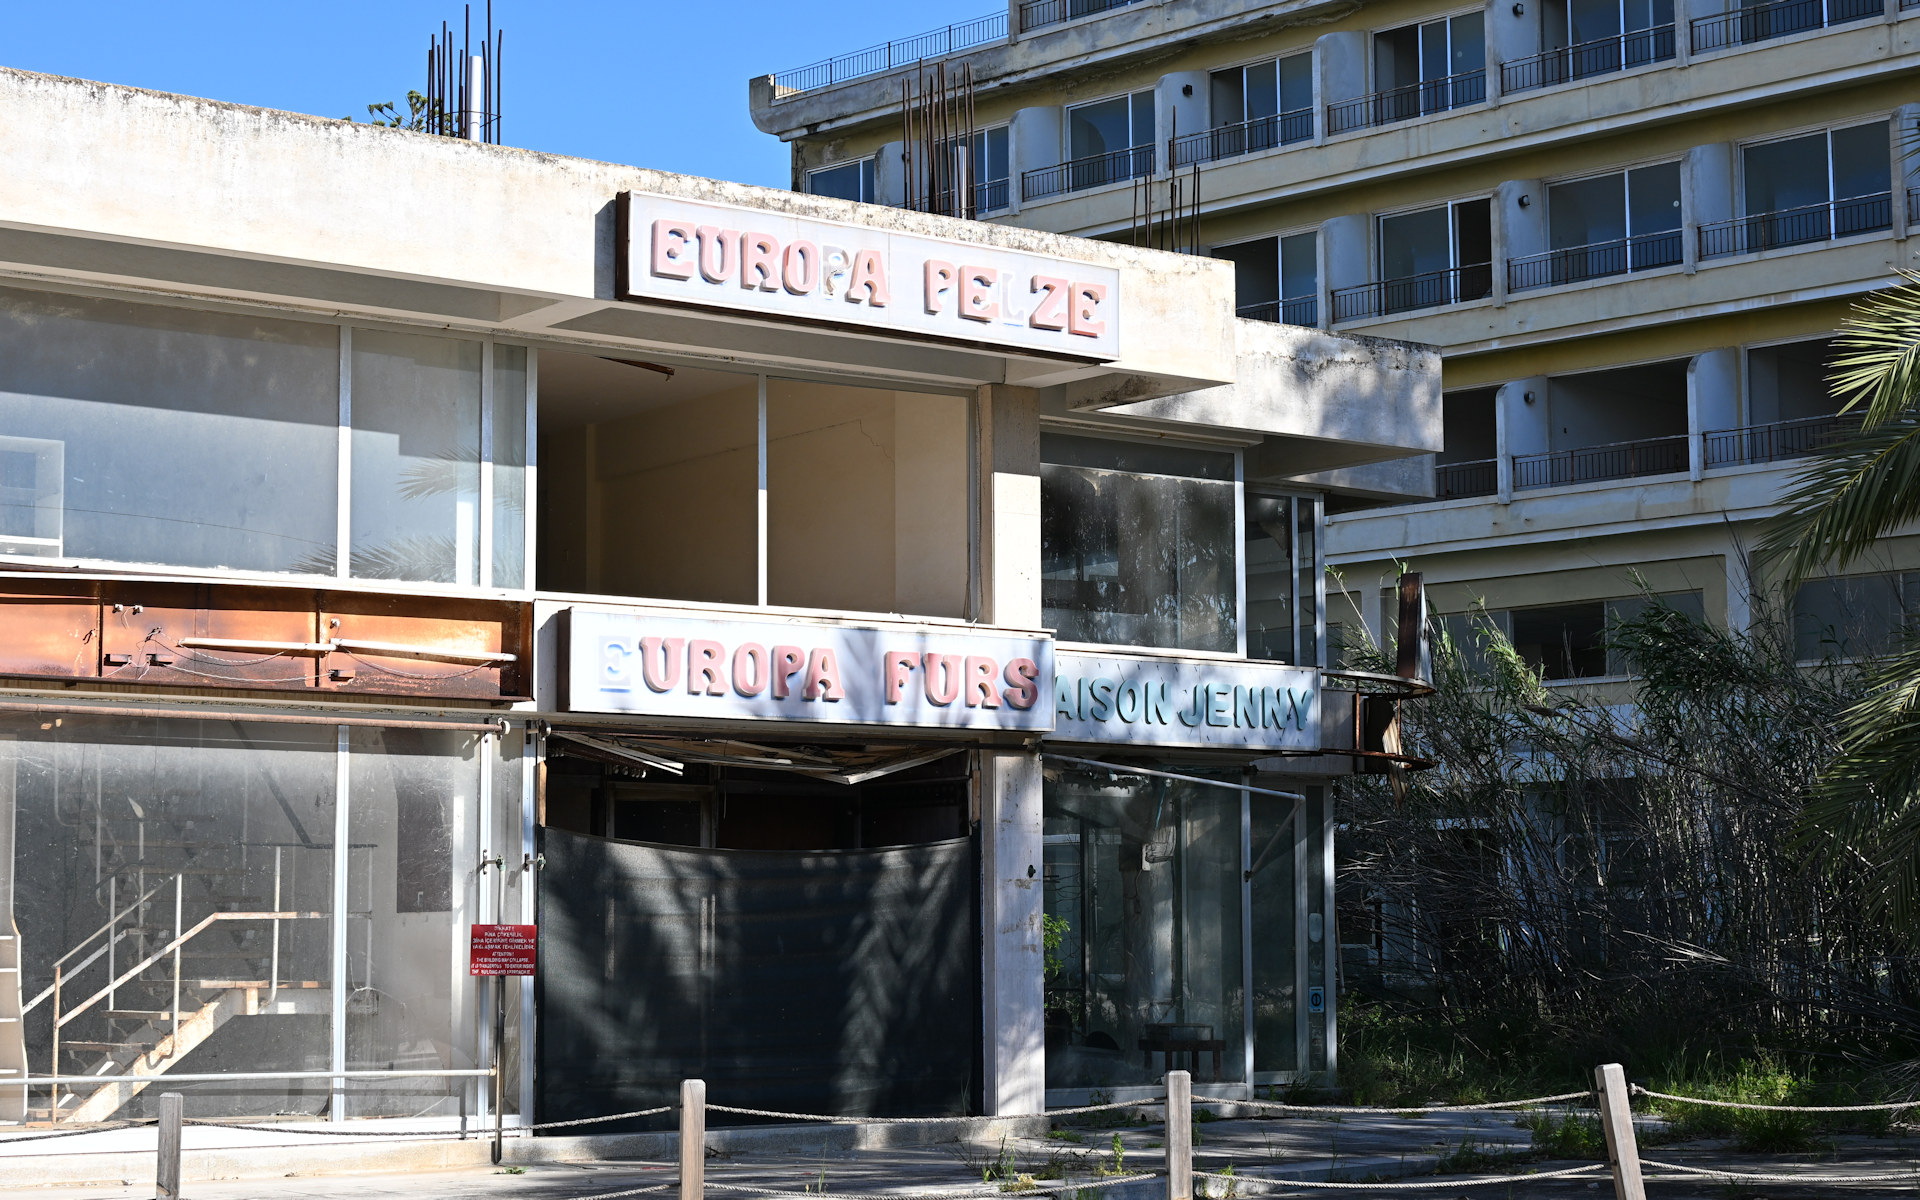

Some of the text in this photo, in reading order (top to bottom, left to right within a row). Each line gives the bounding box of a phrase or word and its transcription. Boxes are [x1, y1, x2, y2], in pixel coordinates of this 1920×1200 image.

[650, 218, 1106, 338] EUROPA PELZE
[884, 651, 1040, 709] FURS
[1055, 674, 1314, 731] AISON JENNY
